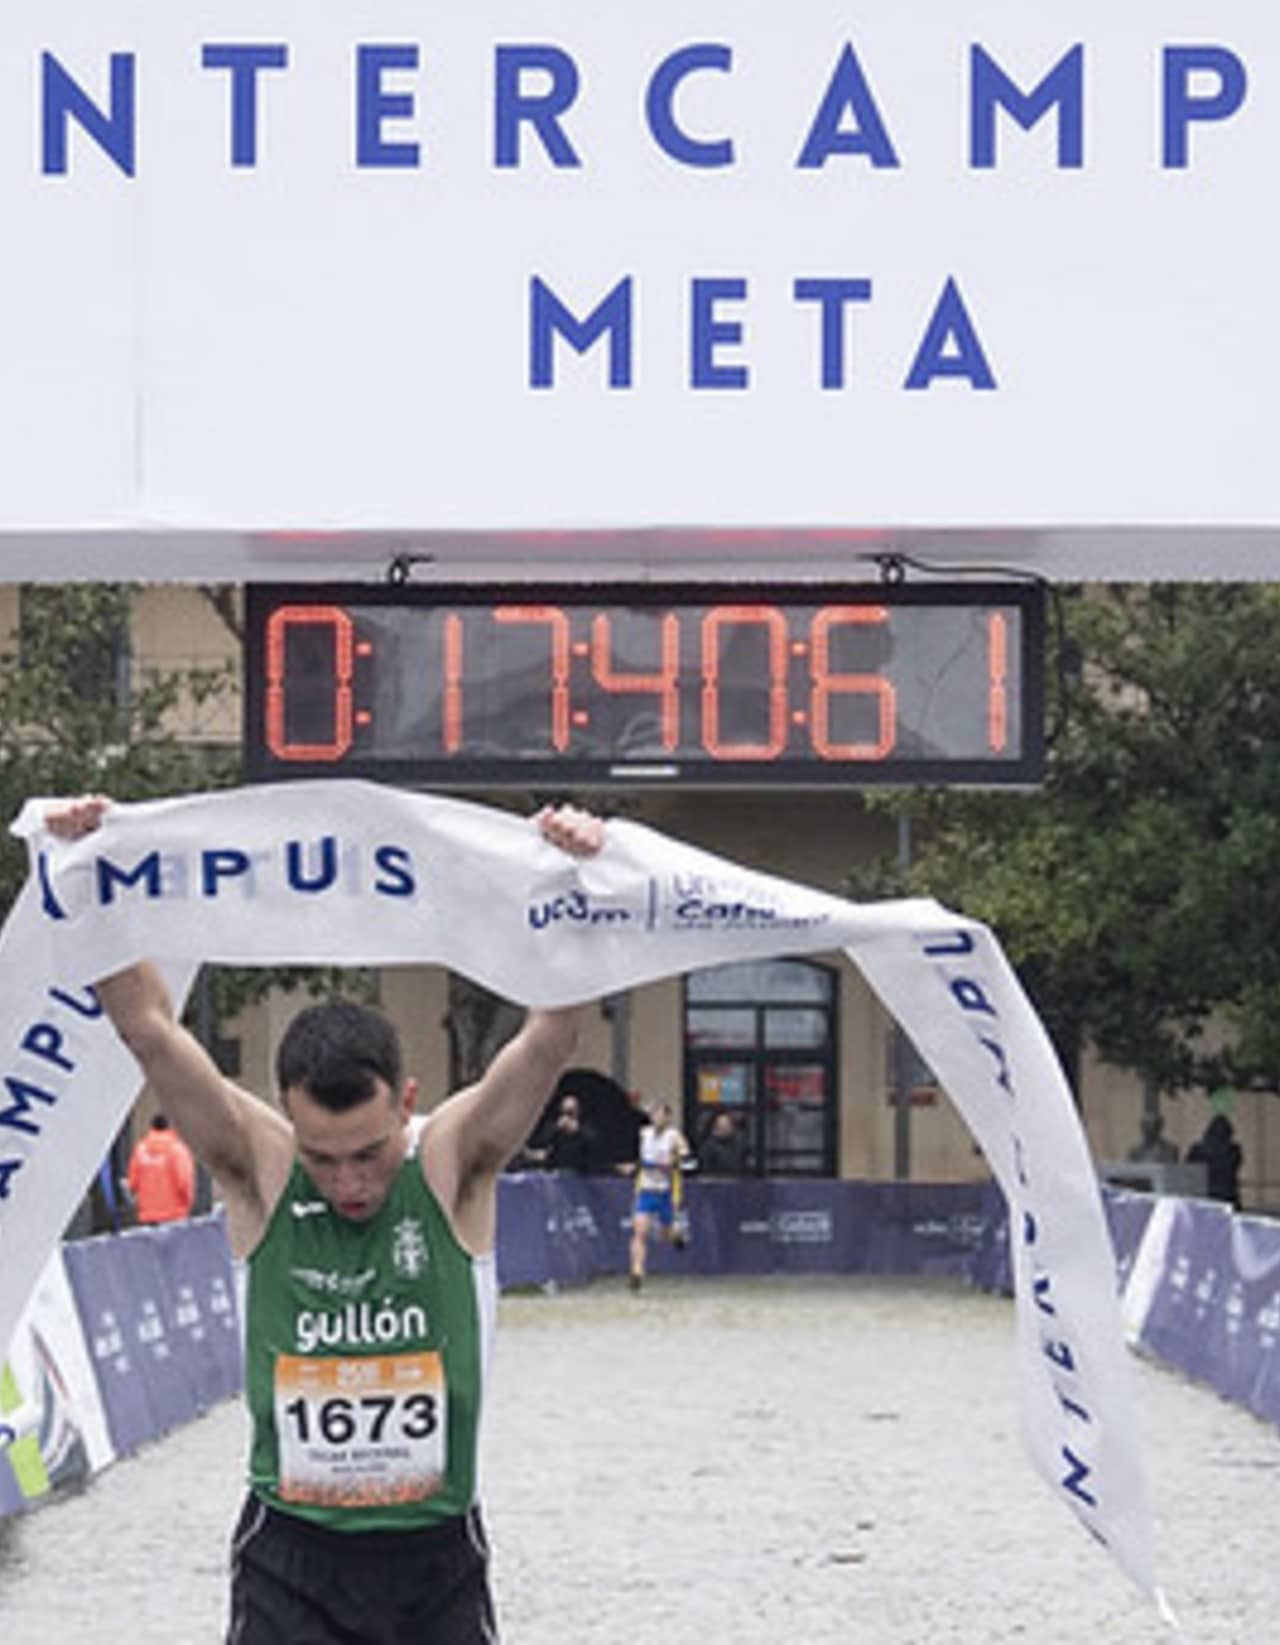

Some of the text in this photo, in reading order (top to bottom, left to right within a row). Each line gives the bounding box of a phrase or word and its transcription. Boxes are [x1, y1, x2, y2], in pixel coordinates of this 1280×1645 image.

[527, 274, 999, 393] META
[266, 604, 1008, 762] 0:17:40:61
[296, 1296, 428, 1354] gullón
[284, 1393, 439, 1446] 1673
